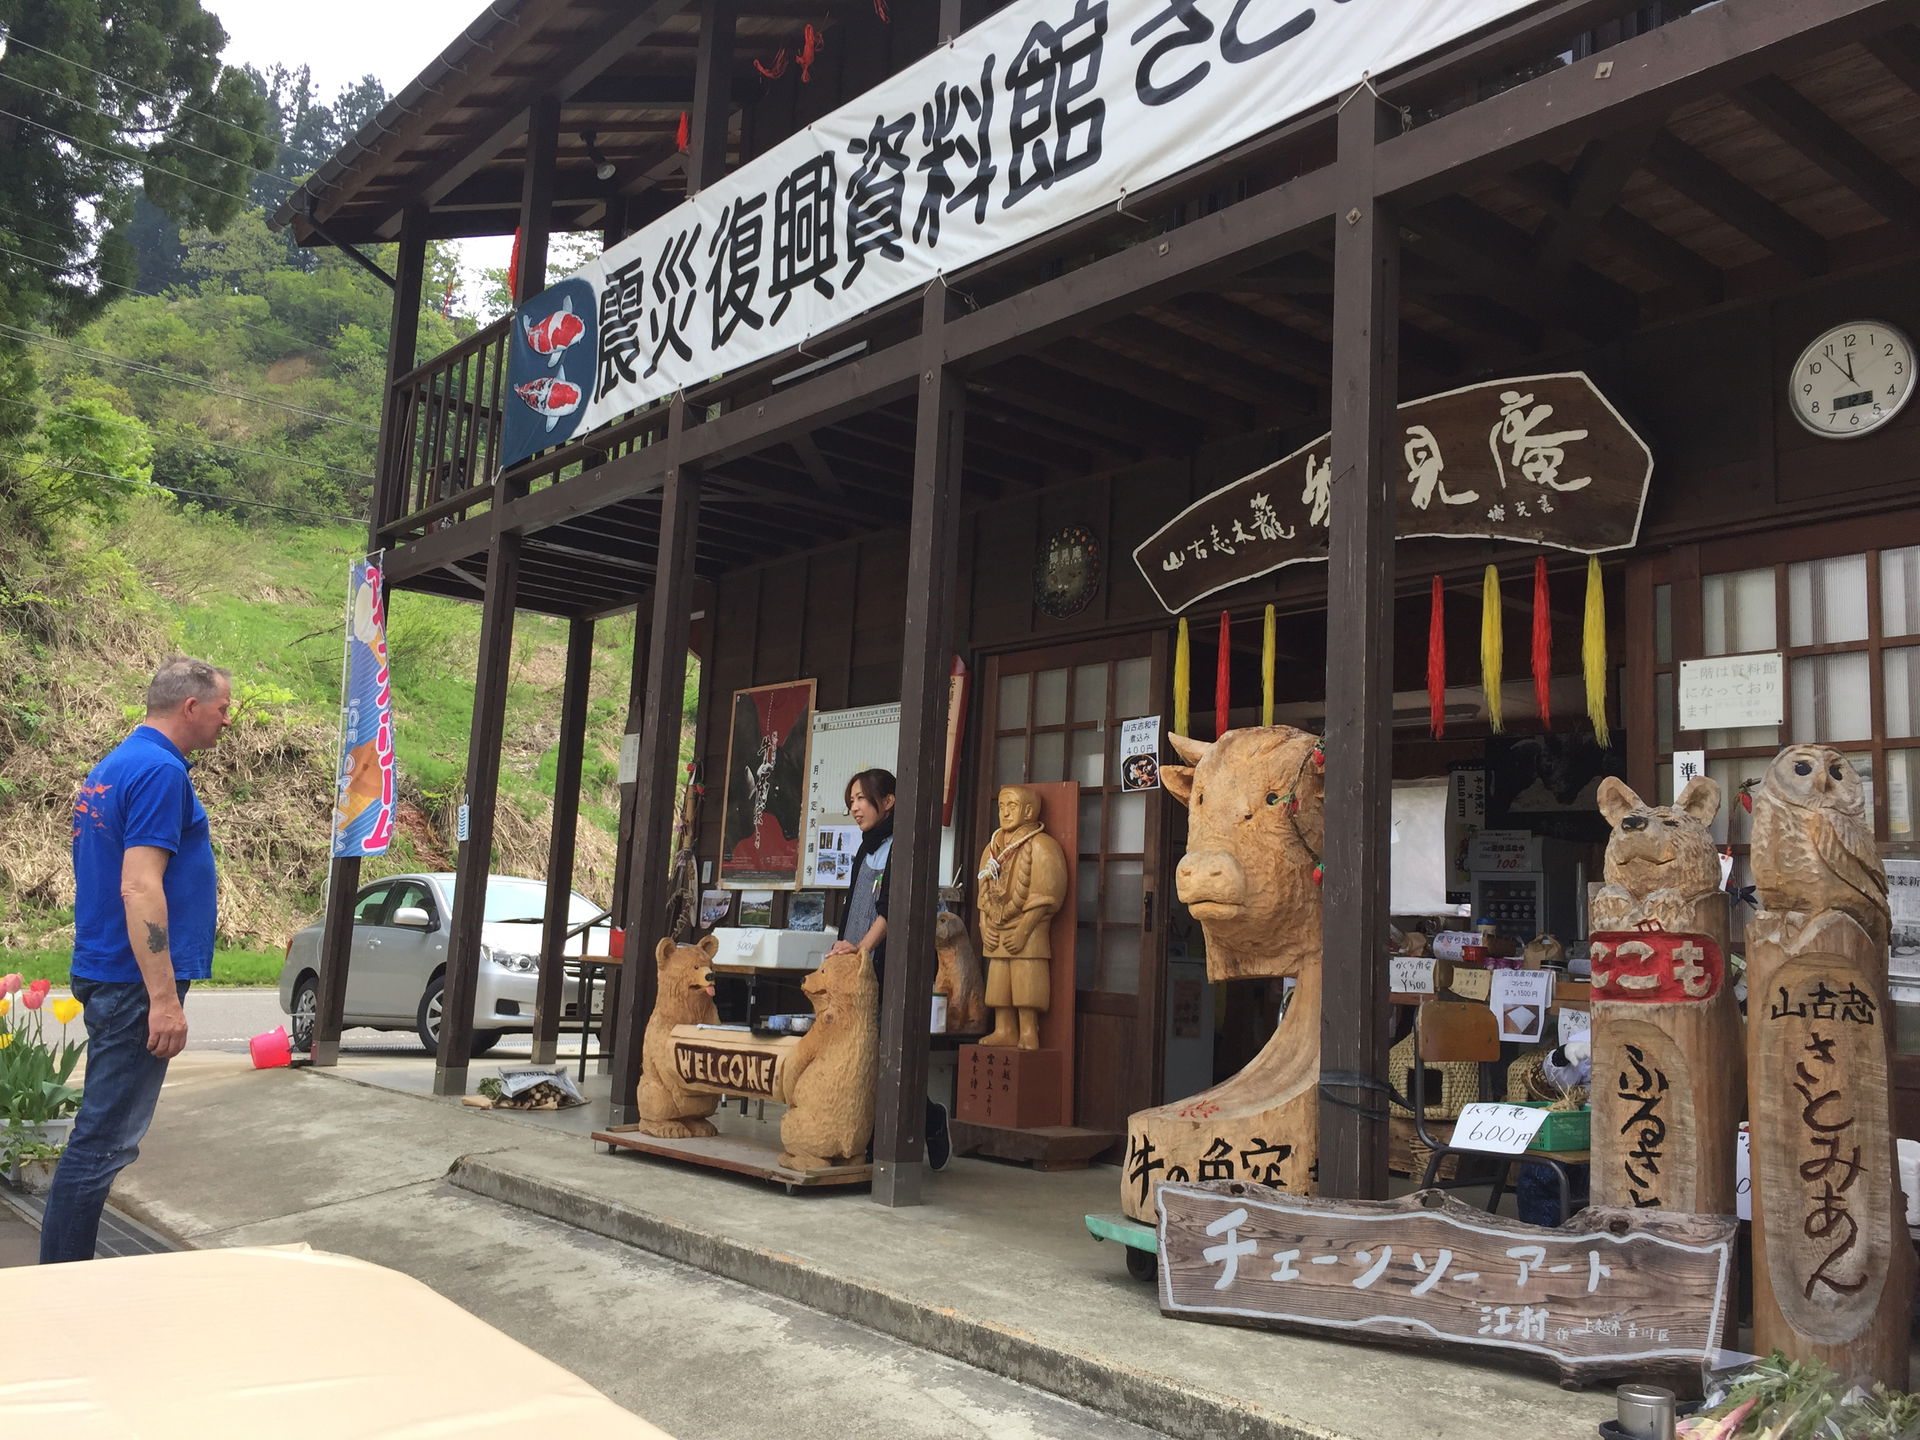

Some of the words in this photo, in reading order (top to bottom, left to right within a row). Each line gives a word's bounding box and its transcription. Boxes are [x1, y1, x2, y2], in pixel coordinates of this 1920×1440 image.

[595, 0, 1108, 403] 震災復興資料館
[1843, 334, 1856, 347] 12
[1870, 333, 1874, 346] 1
[1884, 343, 1894, 357] 2
[1809, 362, 1822, 375] 10
[1894, 361, 1903, 375] 3
[1803, 383, 1813, 396] 9
[1887, 384, 1896, 396] 4
[1811, 401, 1820, 413] 8
[1872, 403, 1882, 415] 5
[1828, 413, 1837, 424] 7
[1850, 413, 1859, 425] 6
[1686, 681, 1774, 698] になっており
[1124, 720, 1158, 732] 山古志和牛
[1130, 733, 1150, 743] 煮込み
[1680, 762, 1697, 781] 準
[1771, 981, 1877, 1025] 山古志
[677, 1048, 773, 1093] WELCOME
[1468, 1121, 1533, 1146] 600円
[1128, 1134, 1319, 1207] 牛の角突
[1793, 1031, 1869, 1300] さとみあん
[1478, 1305, 1549, 1340] 江村
